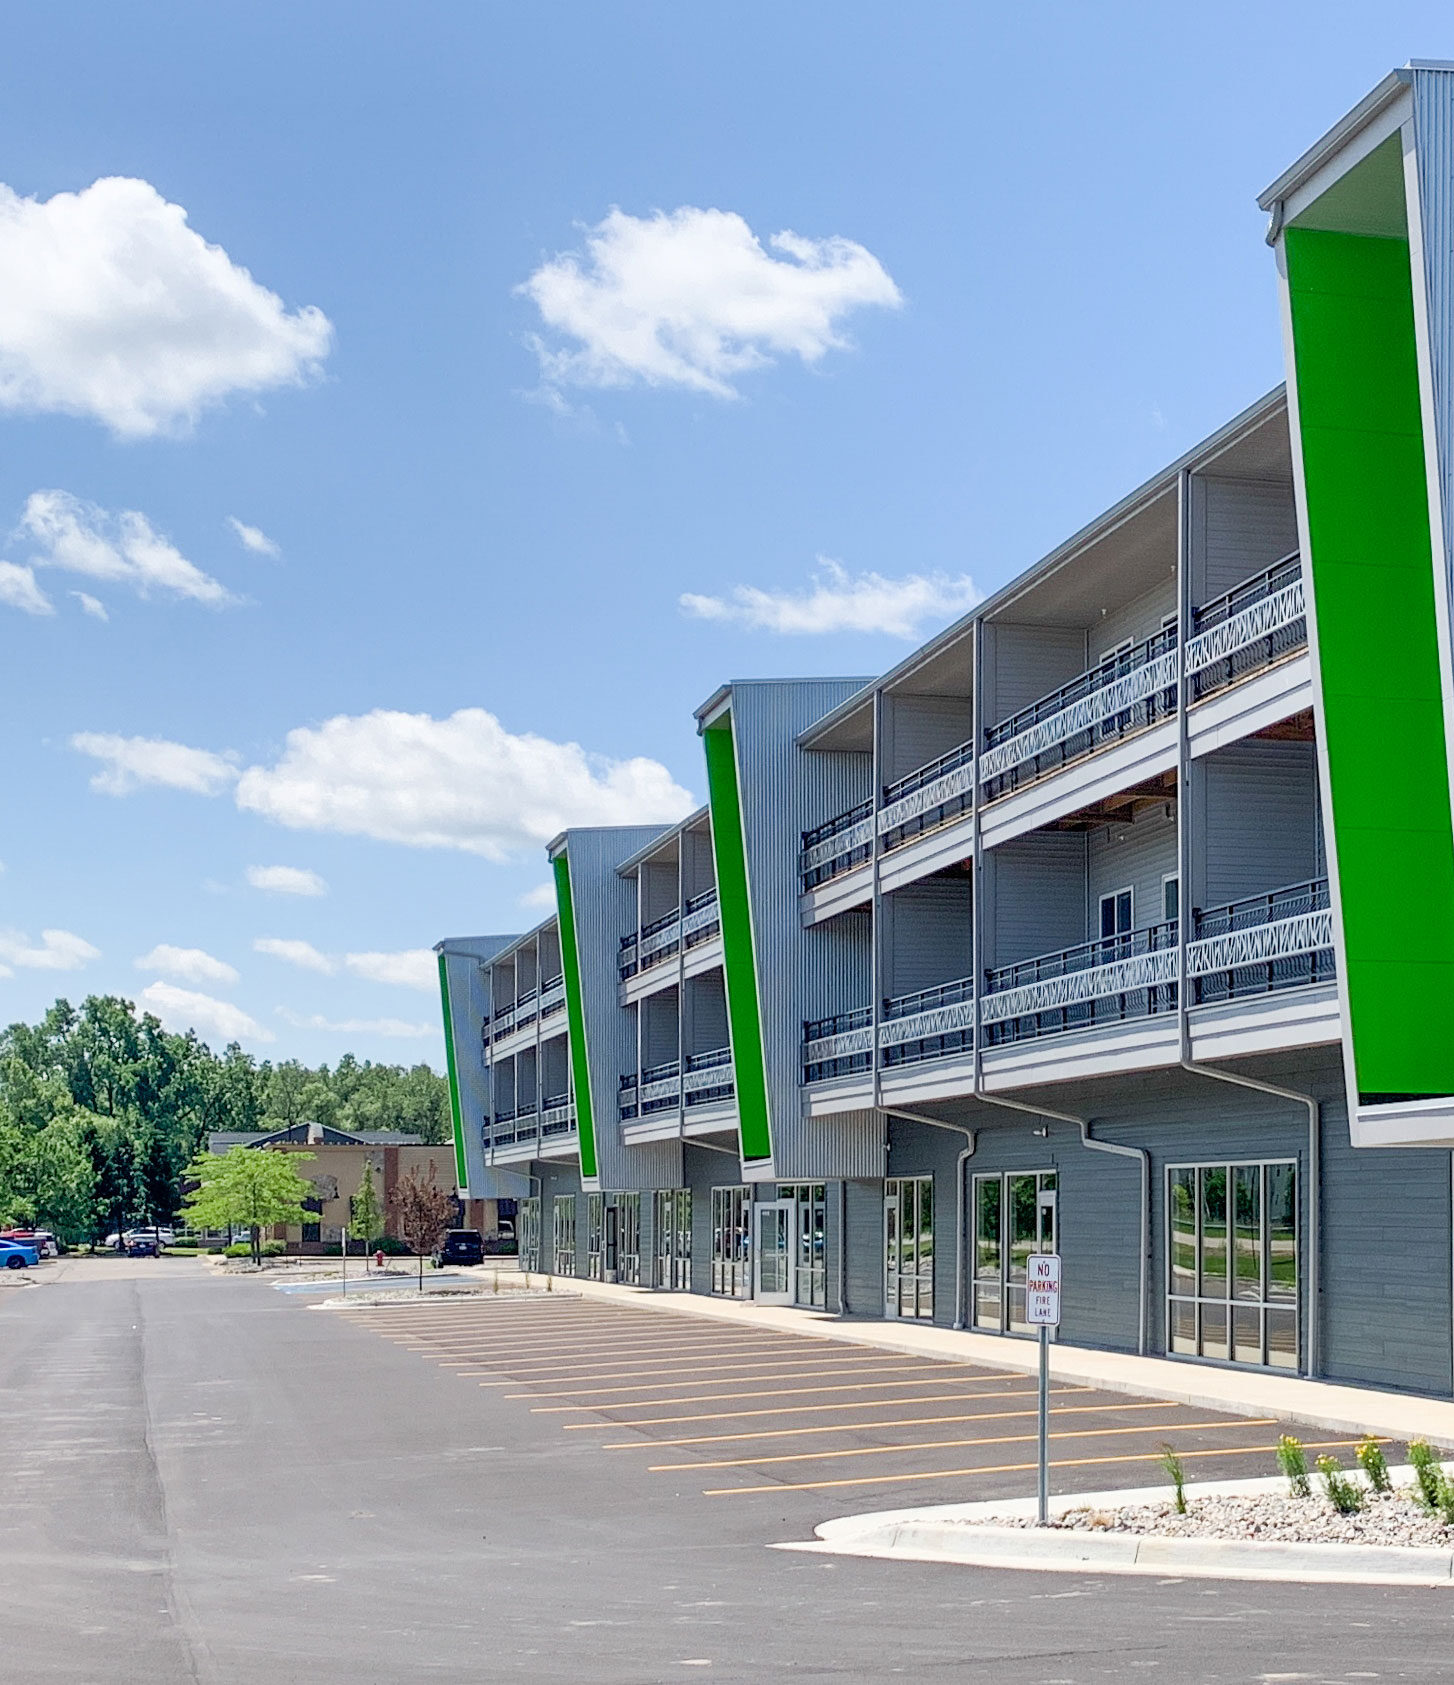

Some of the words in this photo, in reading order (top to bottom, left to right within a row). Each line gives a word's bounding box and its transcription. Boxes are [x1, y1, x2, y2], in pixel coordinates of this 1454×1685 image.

[1037, 1263, 1050, 1277] NO
[1029, 1280, 1058, 1293] PARKING
[1035, 1296, 1051, 1306] FIRE
[1034, 1308, 1051, 1318] LANE
